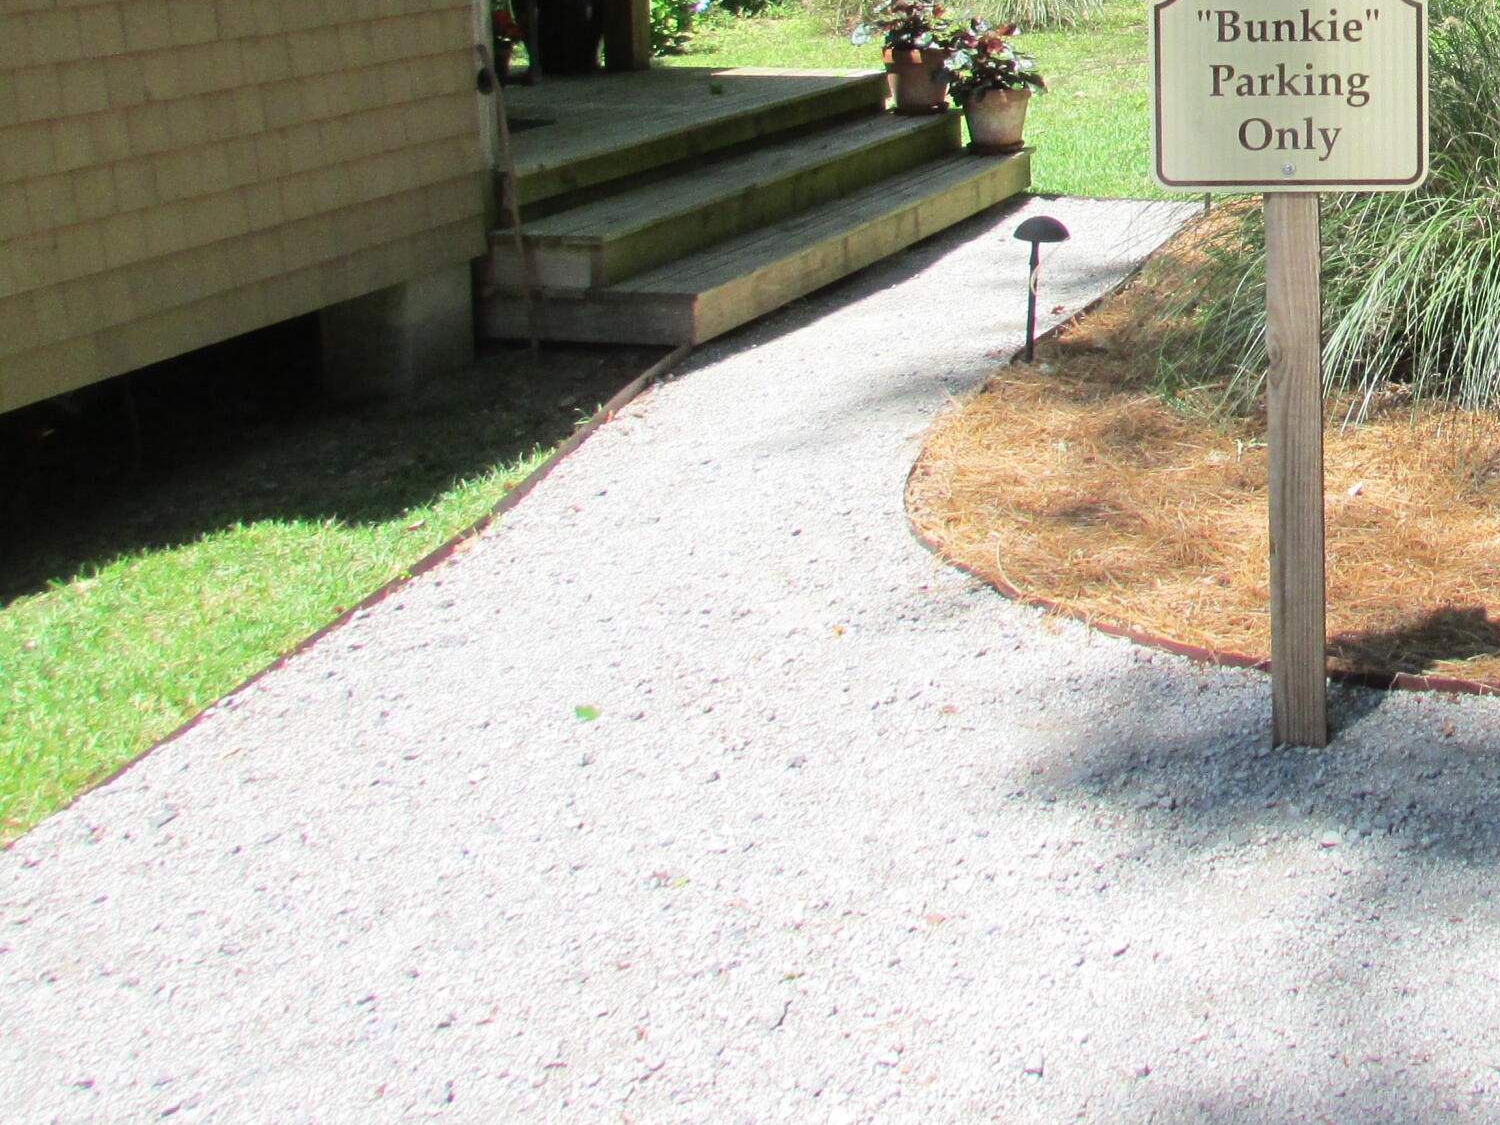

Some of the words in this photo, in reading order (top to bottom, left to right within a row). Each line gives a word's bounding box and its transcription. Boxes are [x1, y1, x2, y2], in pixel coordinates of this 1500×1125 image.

[1197, 8, 1380, 43] "Bunkie"
[1208, 62, 1371, 108] Parking
[1238, 116, 1342, 162] Only
